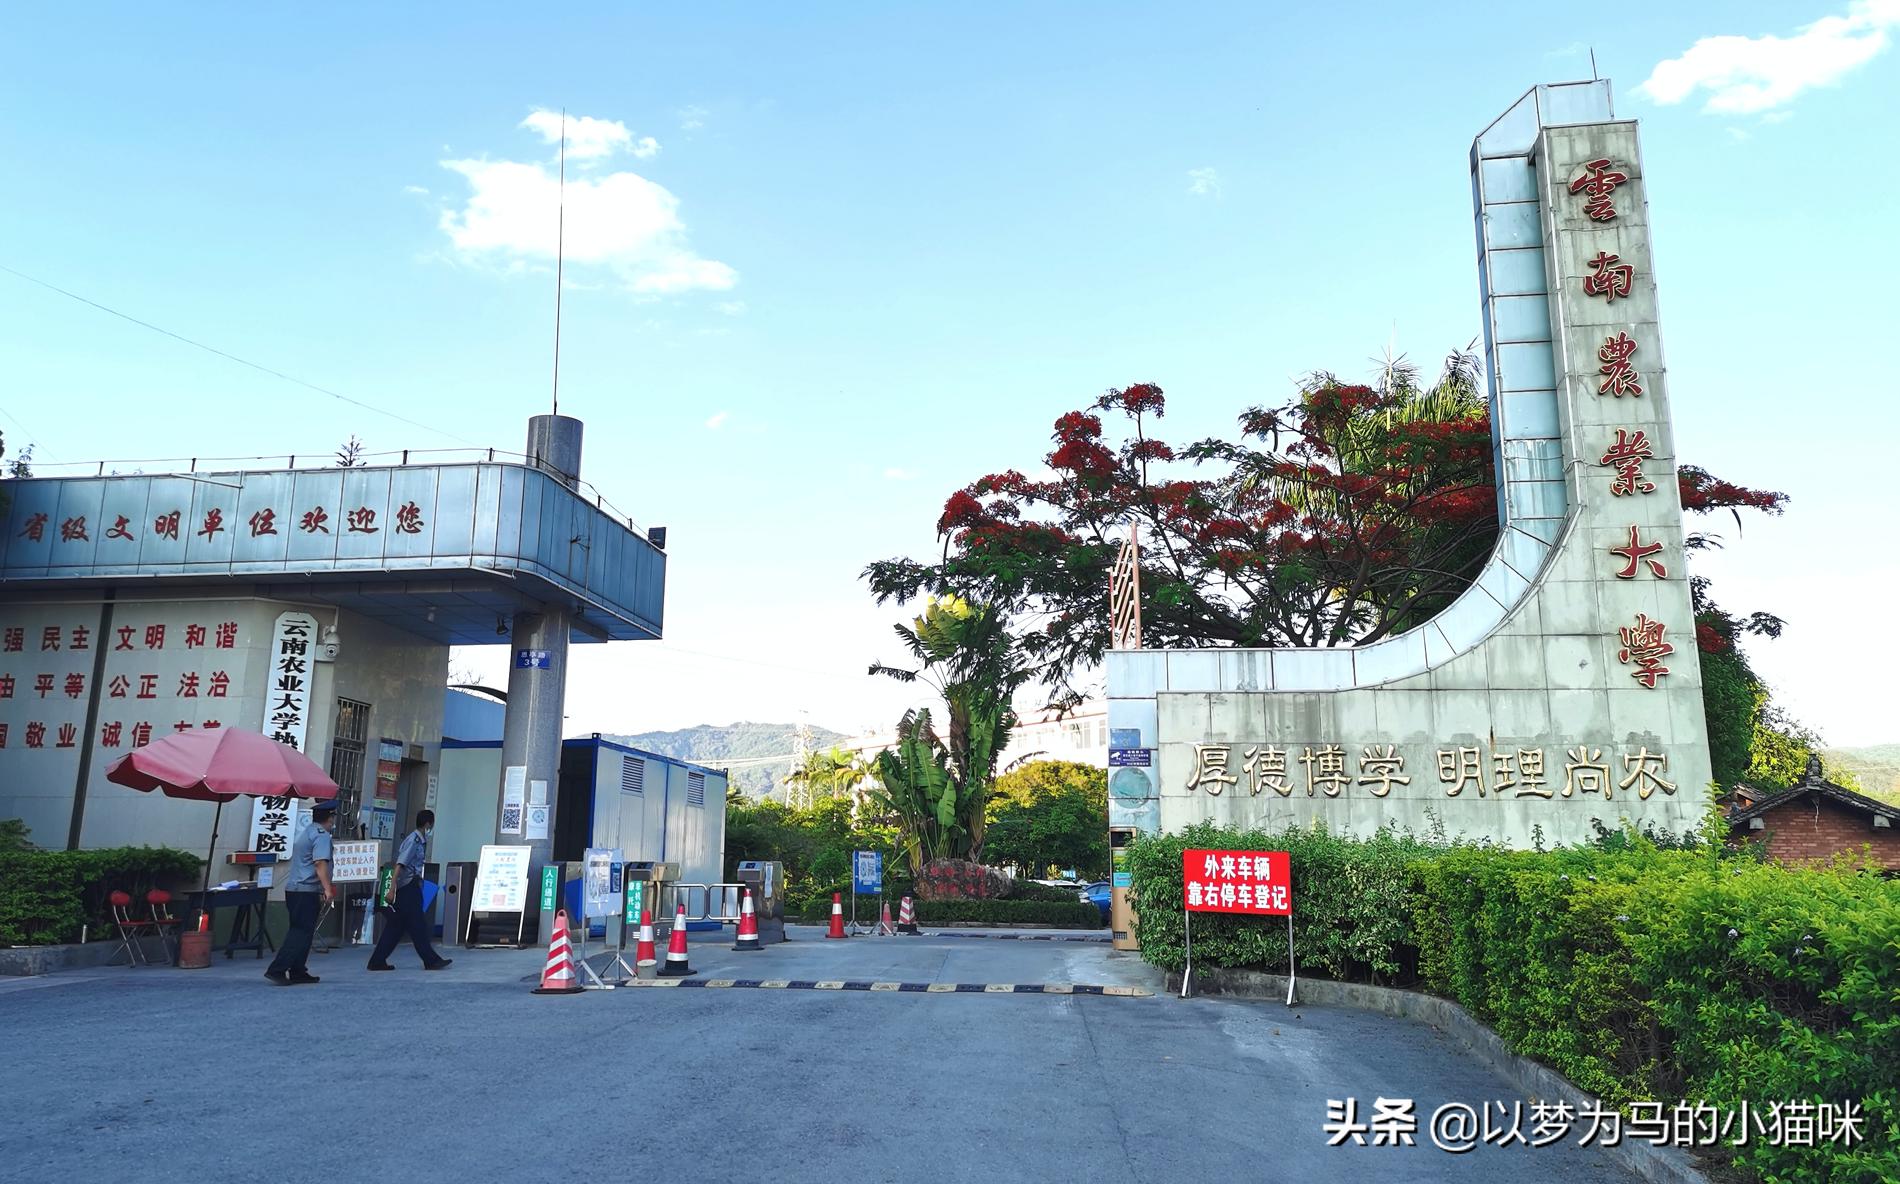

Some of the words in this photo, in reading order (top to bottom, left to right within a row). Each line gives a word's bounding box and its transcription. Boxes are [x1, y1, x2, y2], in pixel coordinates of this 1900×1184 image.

[17, 500, 425, 544] 省级文明单位欢迎您
[3, 627, 24, 652] 强
[41, 625, 90, 651] 民主
[115, 624, 166, 651] 文明
[185, 621, 238, 650] 和谐
[34, 672, 85, 699] 平等
[108, 674, 159, 700] 公正
[176, 670, 230, 698] 法治
[25, 721, 77, 748] 敬业
[101, 721, 153, 748] 诚信
[1186, 743, 1412, 798] 厚德博学
[1435, 744, 1678, 801] 明理尚农
[1204, 854, 1271, 881] 外来车辆
[1187, 881, 1288, 910] 靠右停车登记
